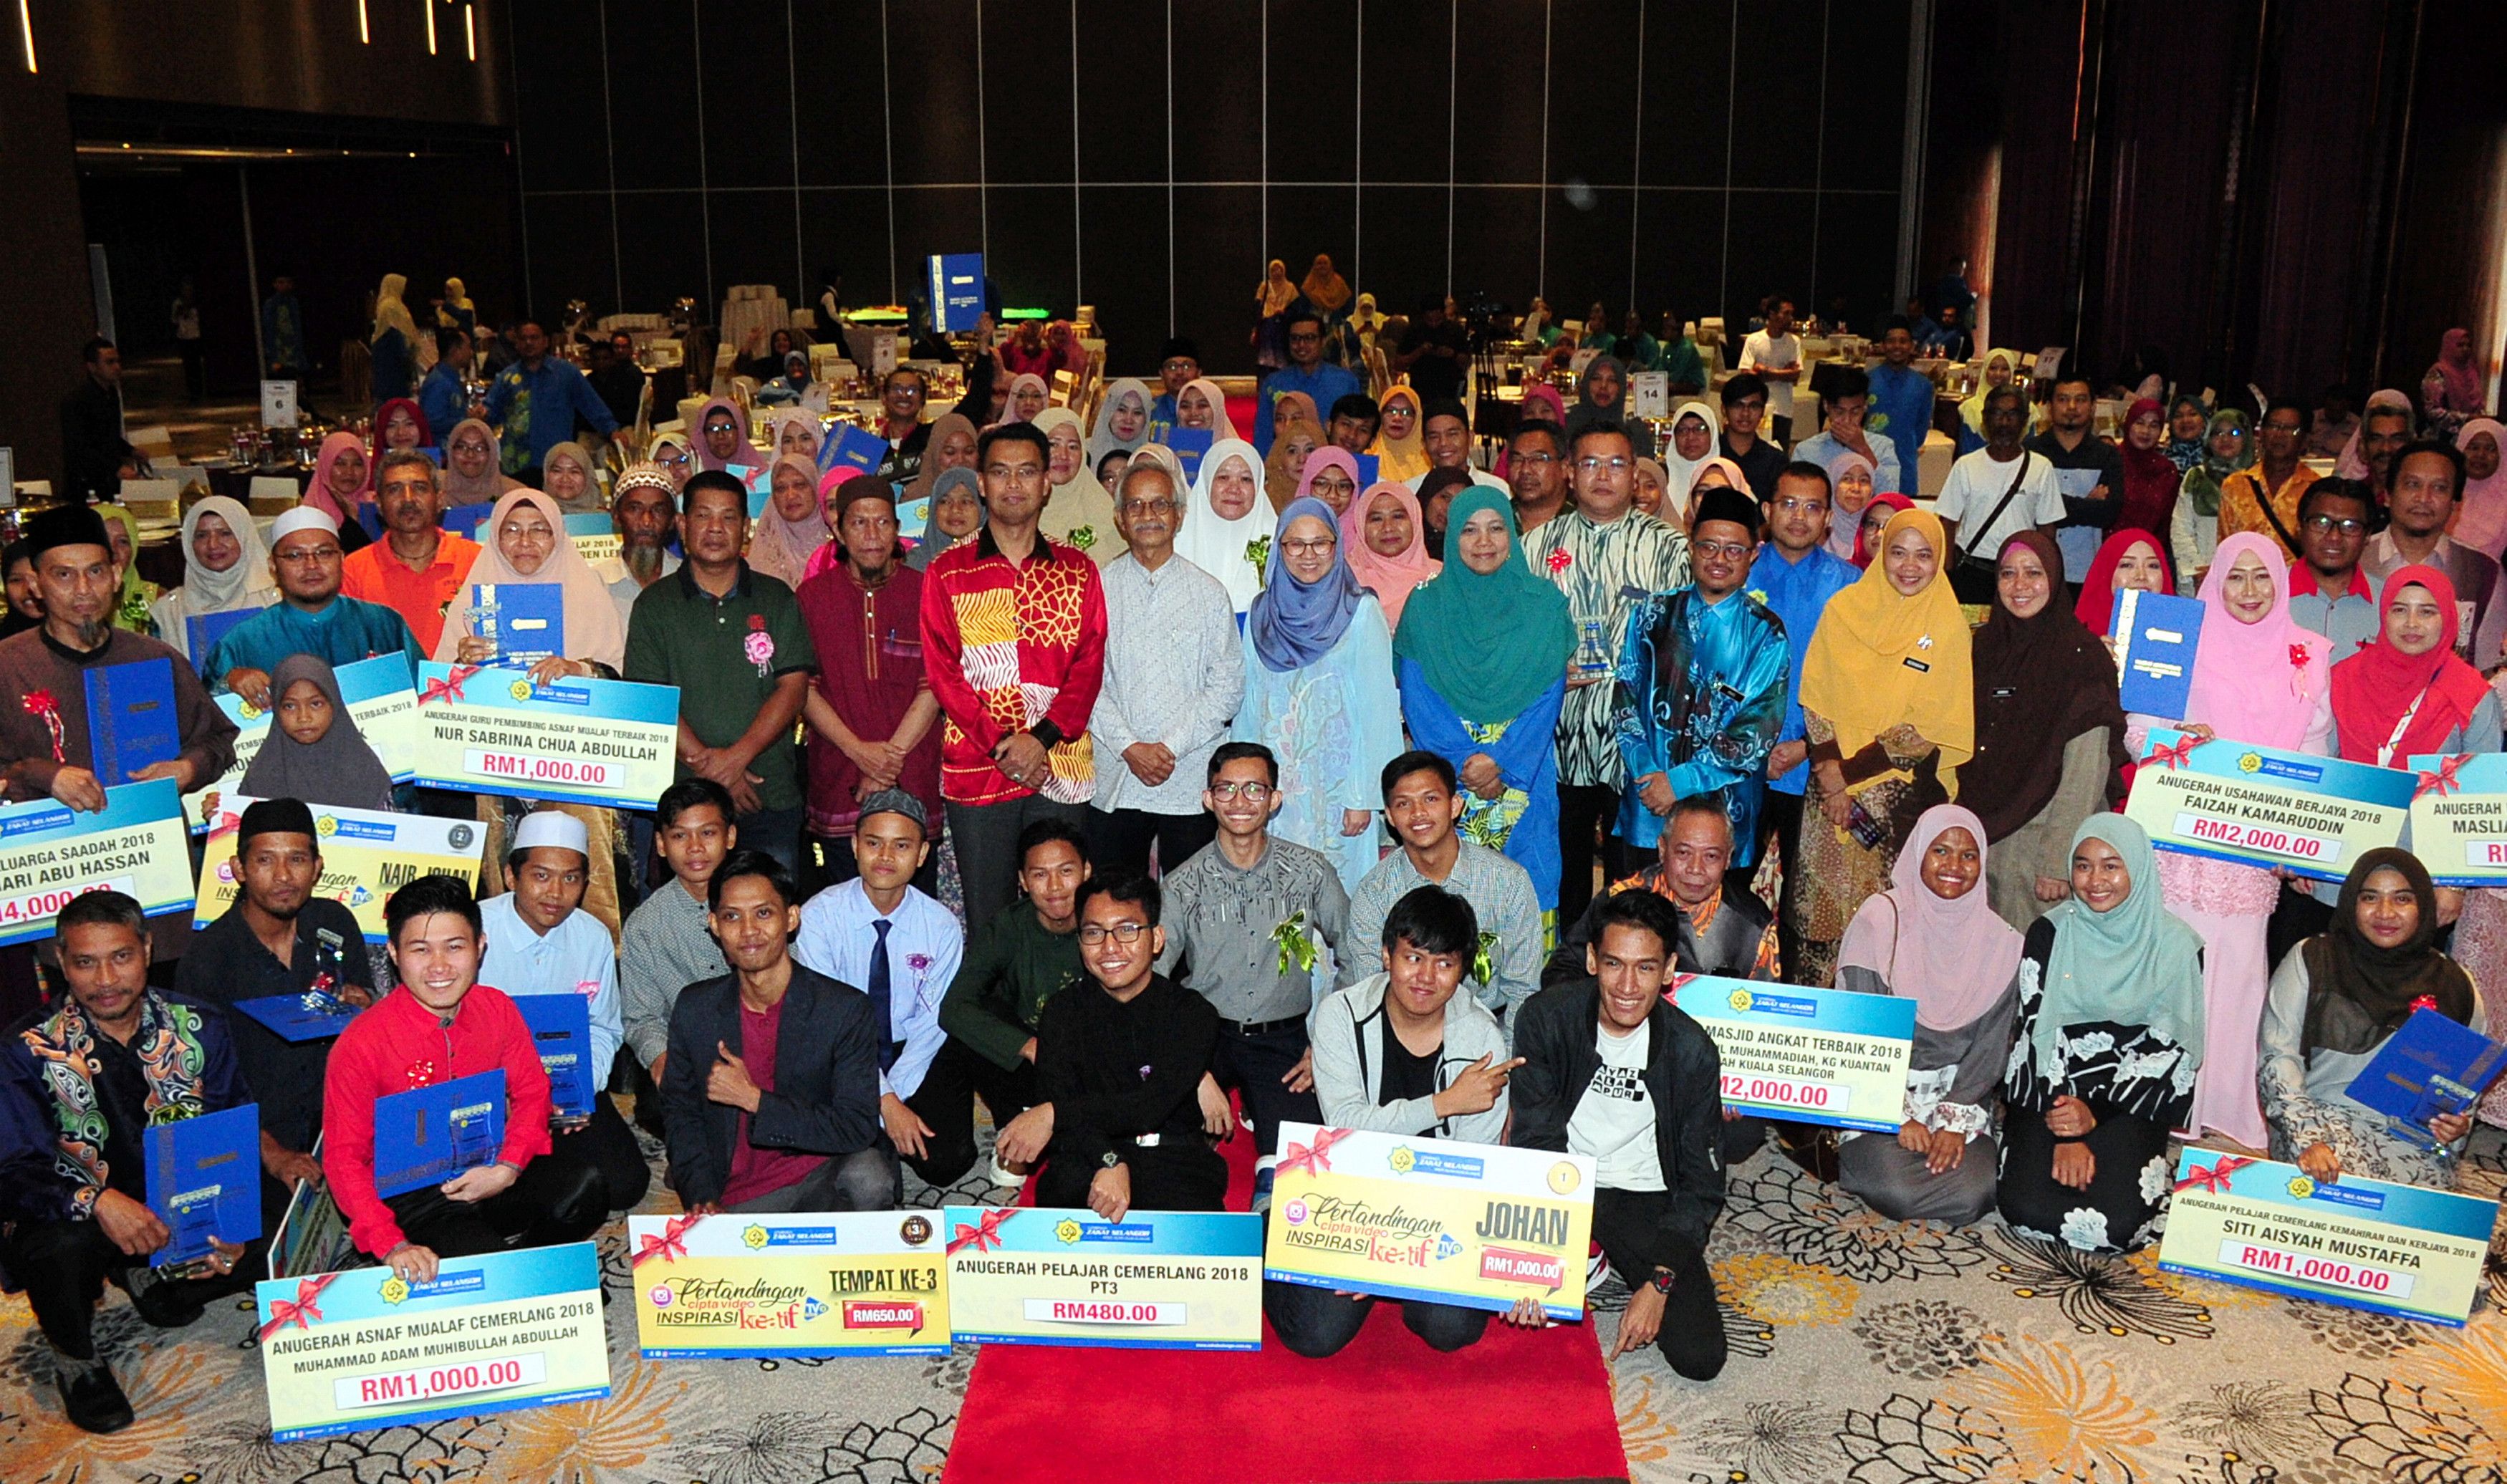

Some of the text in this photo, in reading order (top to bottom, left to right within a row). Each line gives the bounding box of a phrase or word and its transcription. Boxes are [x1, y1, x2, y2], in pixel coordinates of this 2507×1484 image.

[275, 400, 283, 409] 6
[1644, 390, 1658, 399] 14
[355, 707, 390, 721] TERBAIK
[391, 701, 412, 712] 2018
[425, 710, 669, 743] ANUGERAH GURU PEMBIMBING ASNAF MUALAF TERBAIK 2018
[434, 726, 657, 761] NUR SABRINA CHUA ABDULLAH
[483, 753, 606, 784] RM1,000.00
[2157, 775, 2381, 824] ANUGERAH USAHAWAN BERJAYA 2018
[2433, 803, 2501, 815] ANUGERAH
[2184, 796, 2344, 834] FAIZAH KAMARUDDIN
[2193, 819, 2319, 857] RM2,000.00
[0, 832, 155, 872] LUARGA SAADAH 2018
[2488, 844, 2507, 862] R
[0, 851, 150, 892] ARI ABU HASSAN
[379, 862, 417, 884] NAIR
[1705, 1026, 1902, 1059] MASJID ANGKAT TERBAIK 2018
[1730, 1046, 1818, 1066] MUHAMMADIAH,
[1822, 1056, 1837, 1067] KG
[1840, 1058, 1890, 1073] KUANTAN
[1739, 1060, 1774, 1071] KUALA
[1778, 1064, 1834, 1079] SELANGOR
[1301, 1193, 1444, 1240] Pertandingan
[1320, 1220, 1388, 1238] cipta video
[1476, 1202, 1569, 1246] JOHAN
[2180, 1197, 2476, 1259] ANUGERAH PELAJAR CEMERLANG KEMAHIRAN DAN KERJAYA 2018
[912, 1225, 919, 1235] 3
[1286, 1230, 1370, 1253] INSPIRASI
[2223, 1220, 2421, 1269] SITI AISYAH MUSTAFFA
[829, 1268, 938, 1291] TEMPAT KE-3
[956, 1261, 1248, 1281] ANUGERAH PELAJAR CEMERLANG 2018
[1485, 1257, 1559, 1280] RM1,000.00
[2241, 1246, 2389, 1291] RM1,000.00
[441, 1277, 481, 1287] SELANGOR
[664, 1277, 807, 1308] Pertandingan
[1091, 1281, 1118, 1294] PT3
[688, 1298, 755, 1310] cipta video
[852, 1309, 914, 1323] RM650.00
[1054, 1303, 1157, 1321] RM480.00
[273, 1301, 595, 1355] ANUGERAH ASNAF MUALAF CEMERLANG 2018
[657, 1312, 738, 1324] INSPIRASI
[294, 1327, 579, 1374] MUHAMMAD ADAM MUHIBULLAH ABDULLAH
[360, 1361, 521, 1402] RM1,000.00
